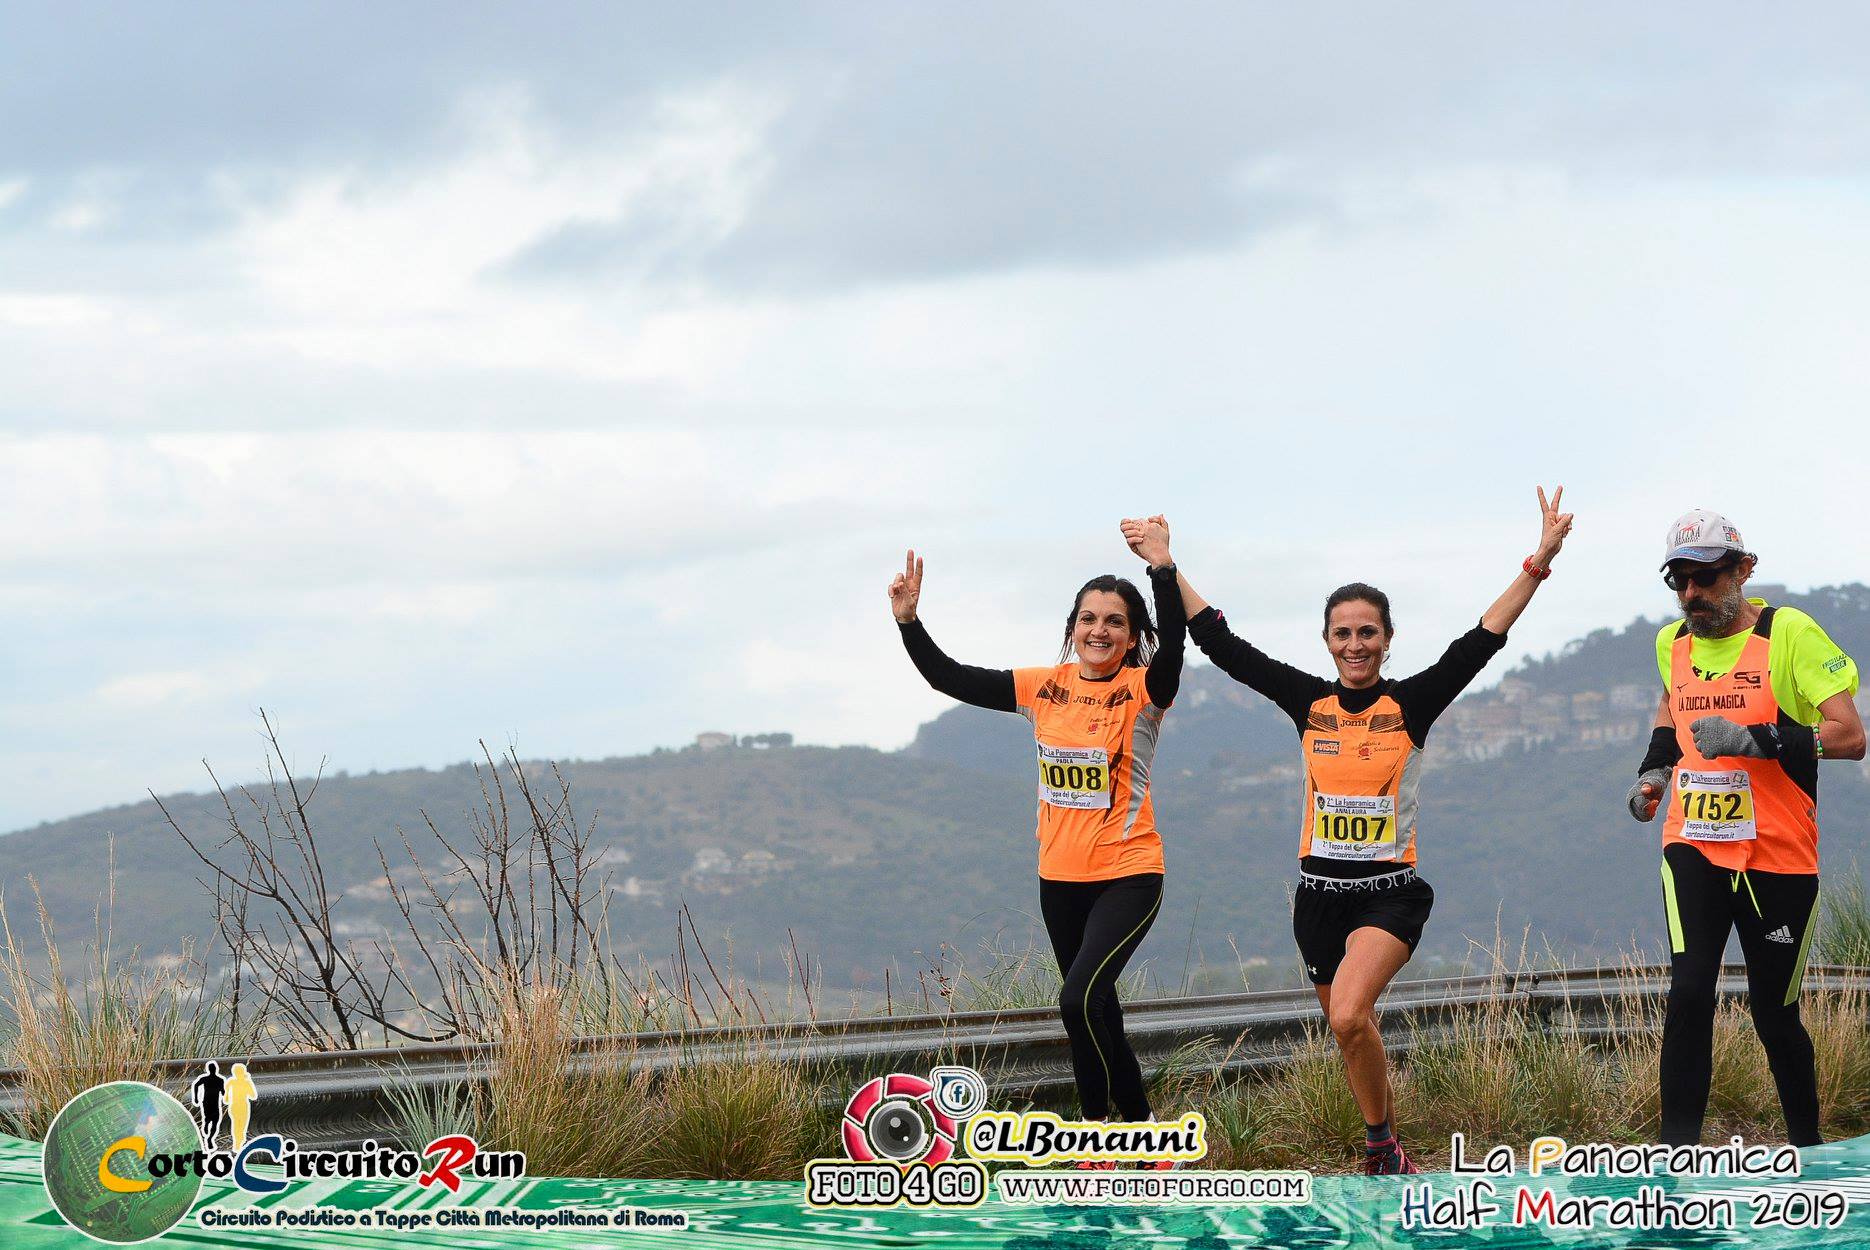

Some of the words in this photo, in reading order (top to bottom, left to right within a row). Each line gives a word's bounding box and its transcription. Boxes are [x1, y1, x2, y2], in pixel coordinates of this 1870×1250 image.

[1679, 696, 1685, 711] LA
[1686, 696, 1711, 711] ZUCCA
[1713, 694, 1746, 709] MAGICA
[1340, 719, 1367, 727] Joma
[1042, 762, 1102, 791] 1008
[1682, 792, 1744, 820] 1152
[1321, 815, 1387, 841] 1007
[1765, 934, 1794, 943] adidas
